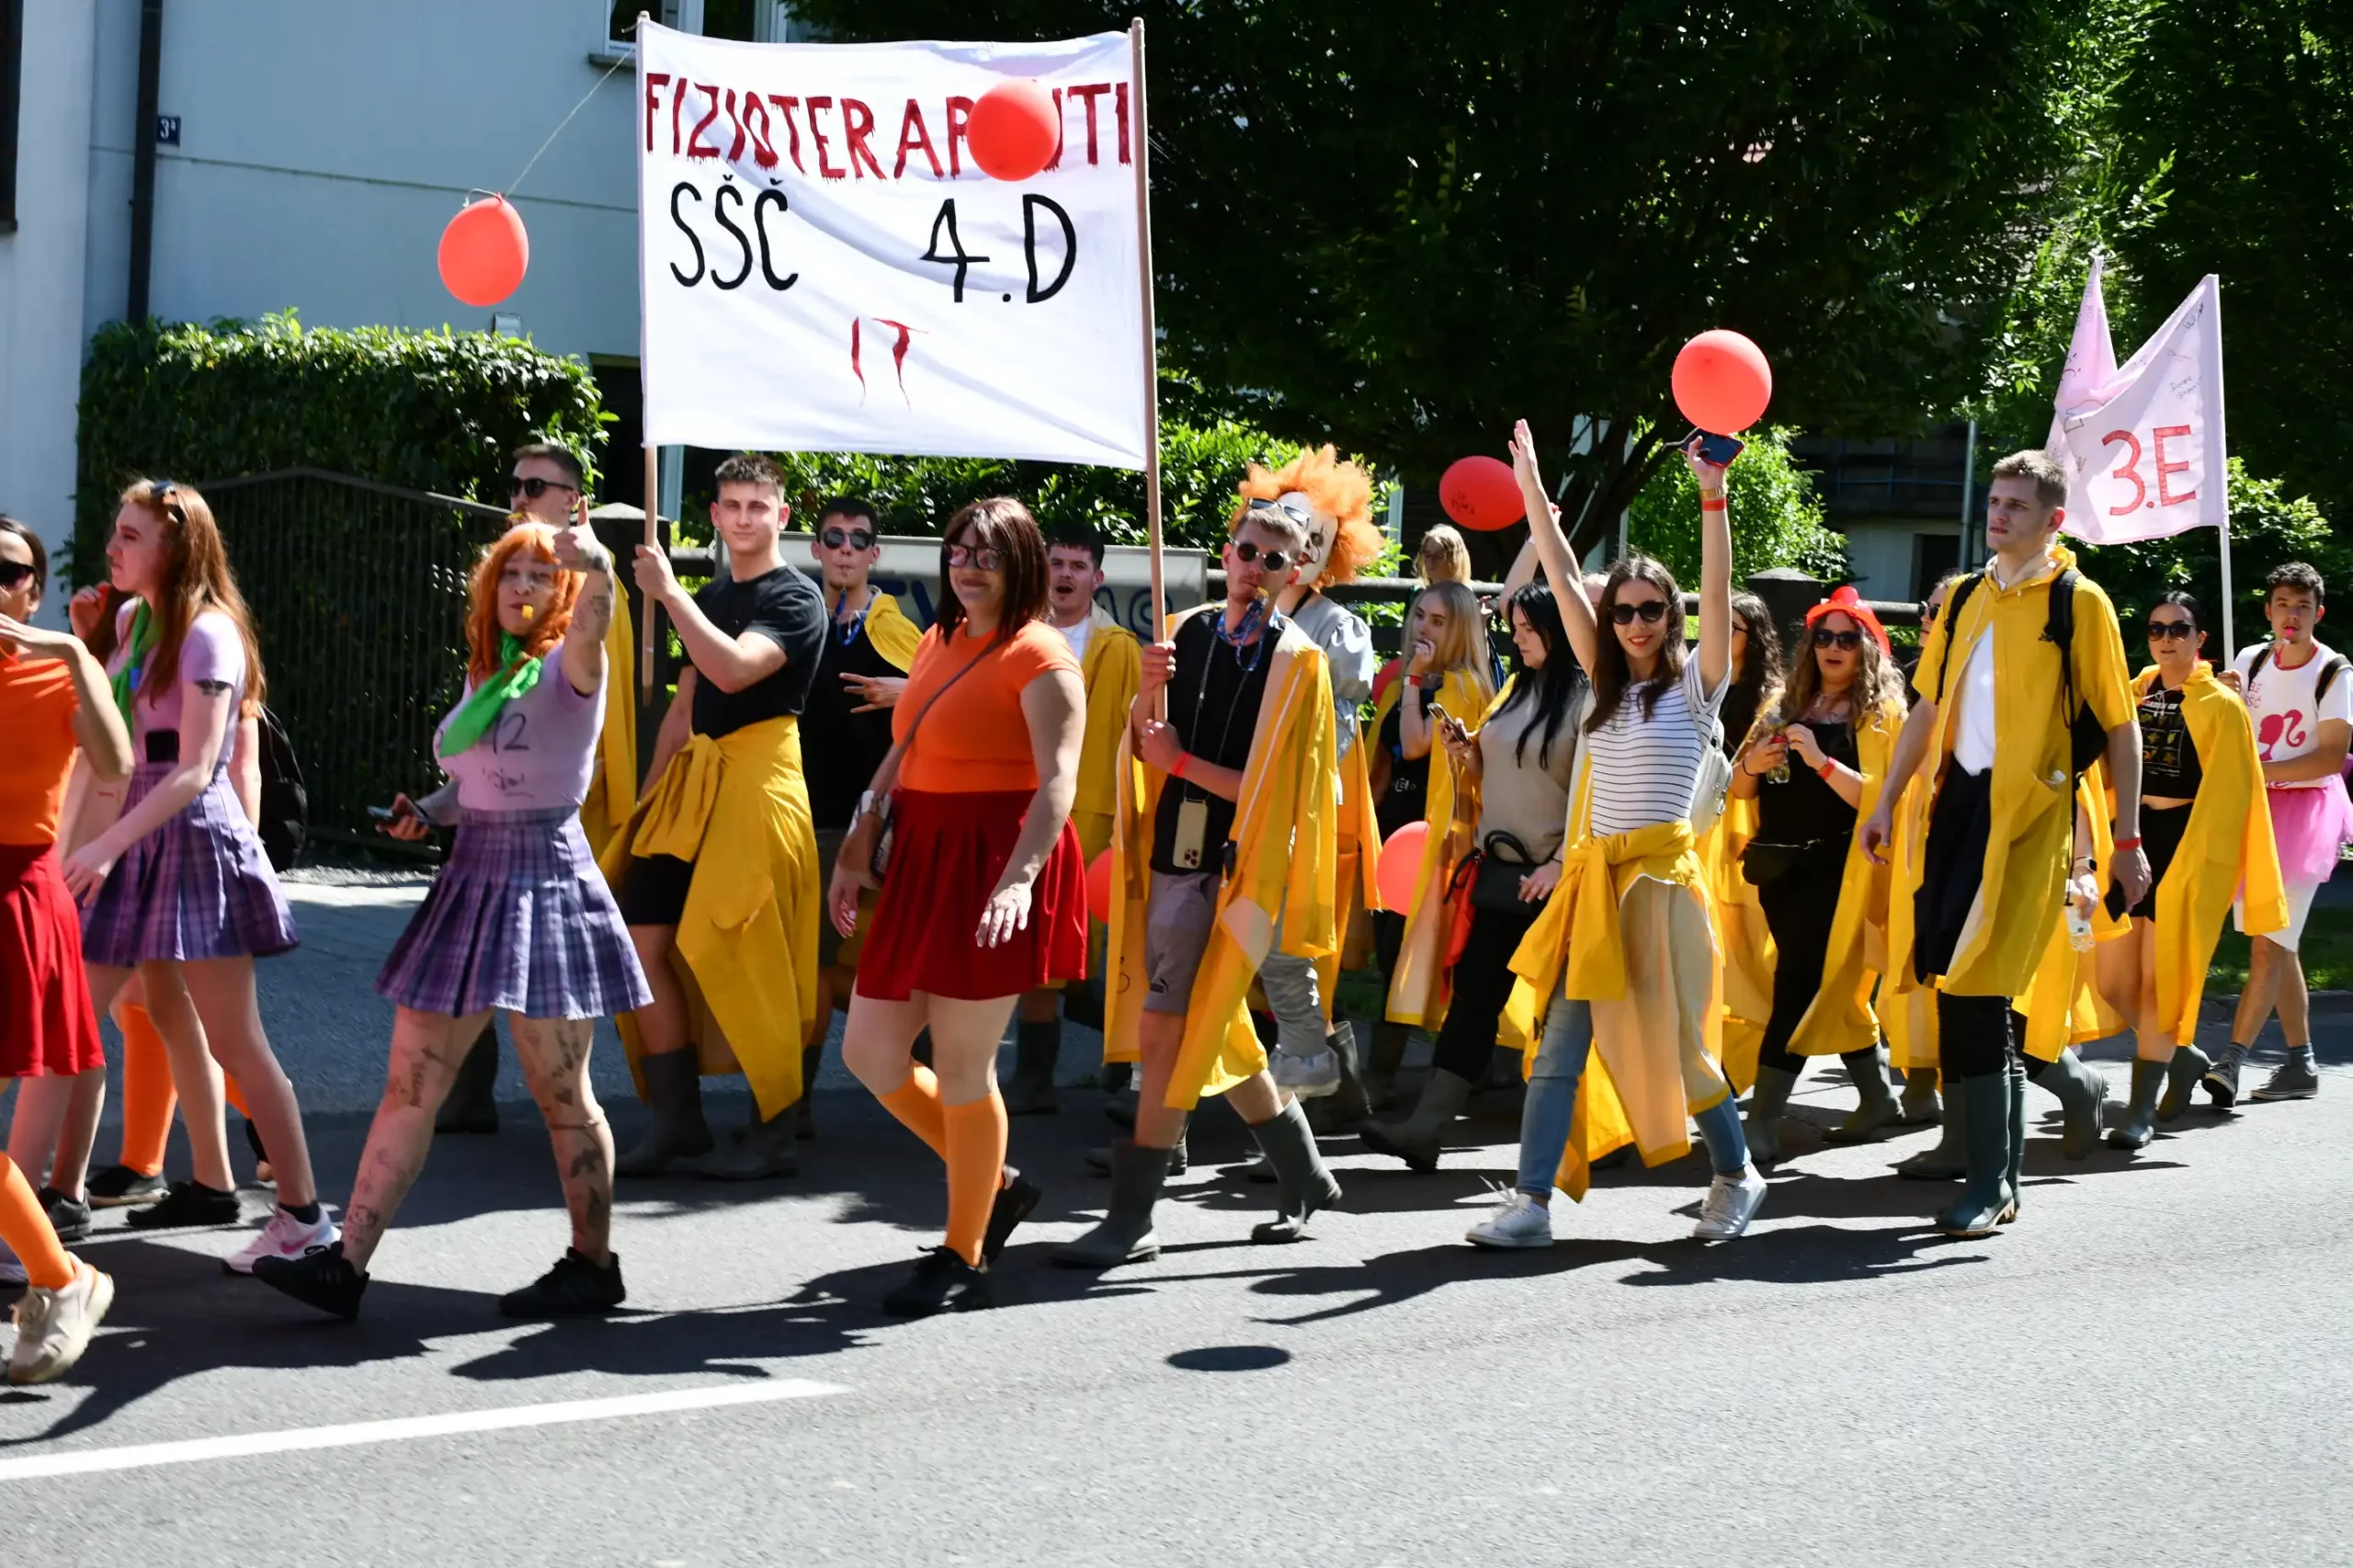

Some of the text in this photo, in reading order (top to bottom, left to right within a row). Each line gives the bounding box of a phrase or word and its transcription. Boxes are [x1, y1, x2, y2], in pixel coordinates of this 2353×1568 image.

[646, 73, 1131, 182] FIZIOTERAPTI
[670, 173, 799, 291] SŠČ
[851, 315, 929, 411] IT
[2101, 424, 2197, 516] 3.E
